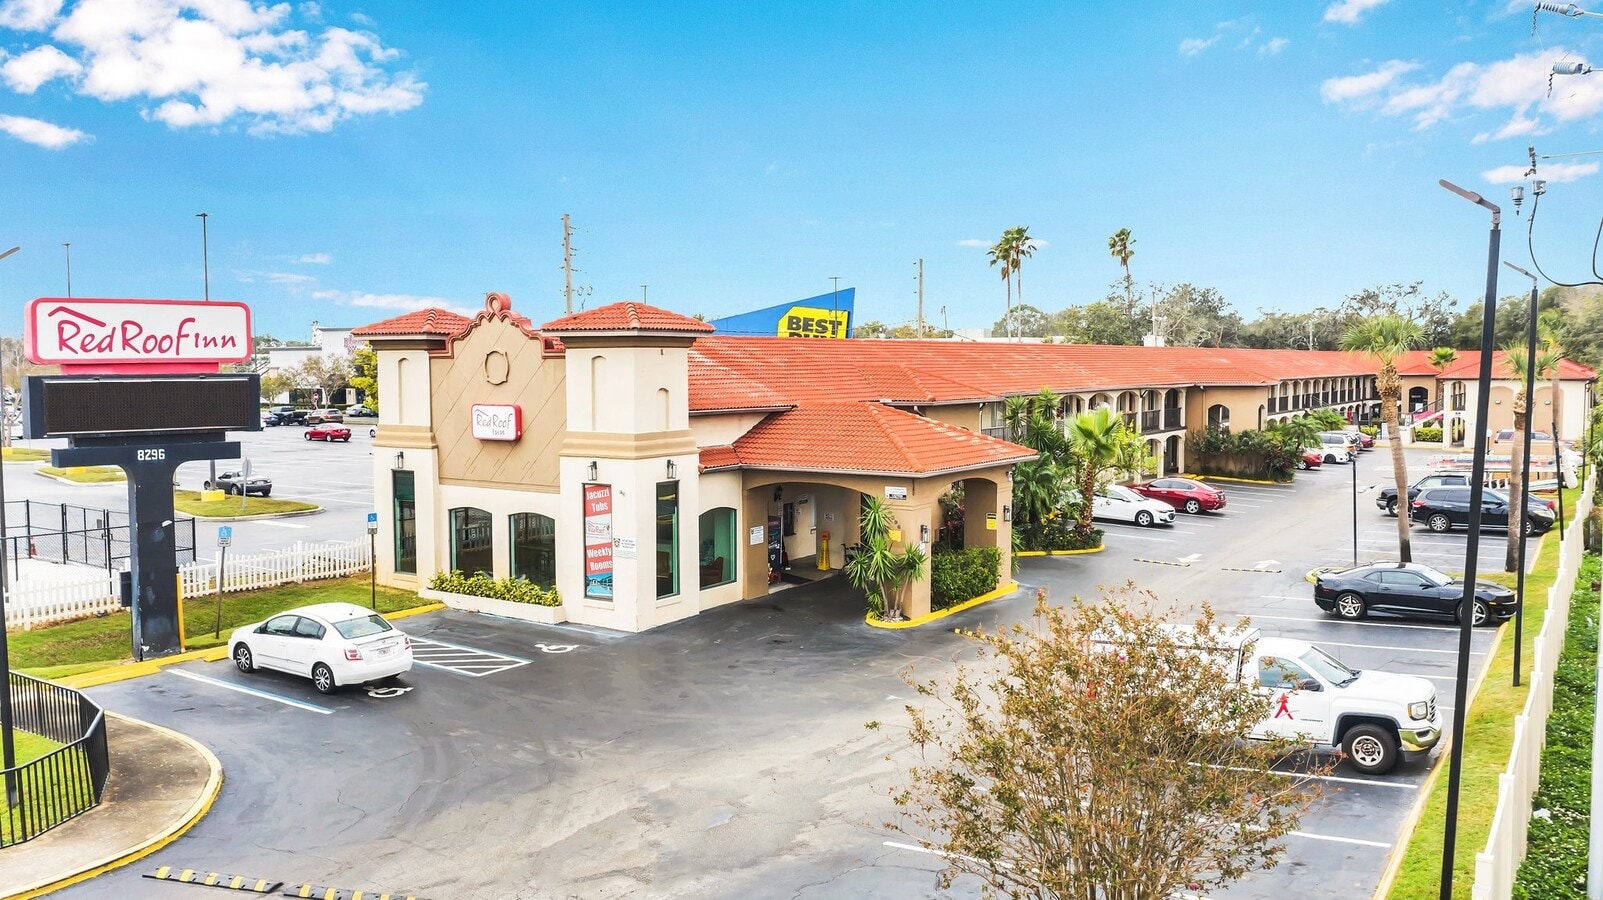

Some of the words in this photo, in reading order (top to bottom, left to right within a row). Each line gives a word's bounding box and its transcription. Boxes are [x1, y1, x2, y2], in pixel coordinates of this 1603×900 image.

[787, 315, 842, 336] BEST
[137, 449, 165, 461] 8296
[591, 502, 609, 512] Tubs
[586, 547, 612, 558] Weekly
[590, 560, 613, 571] Rooms
